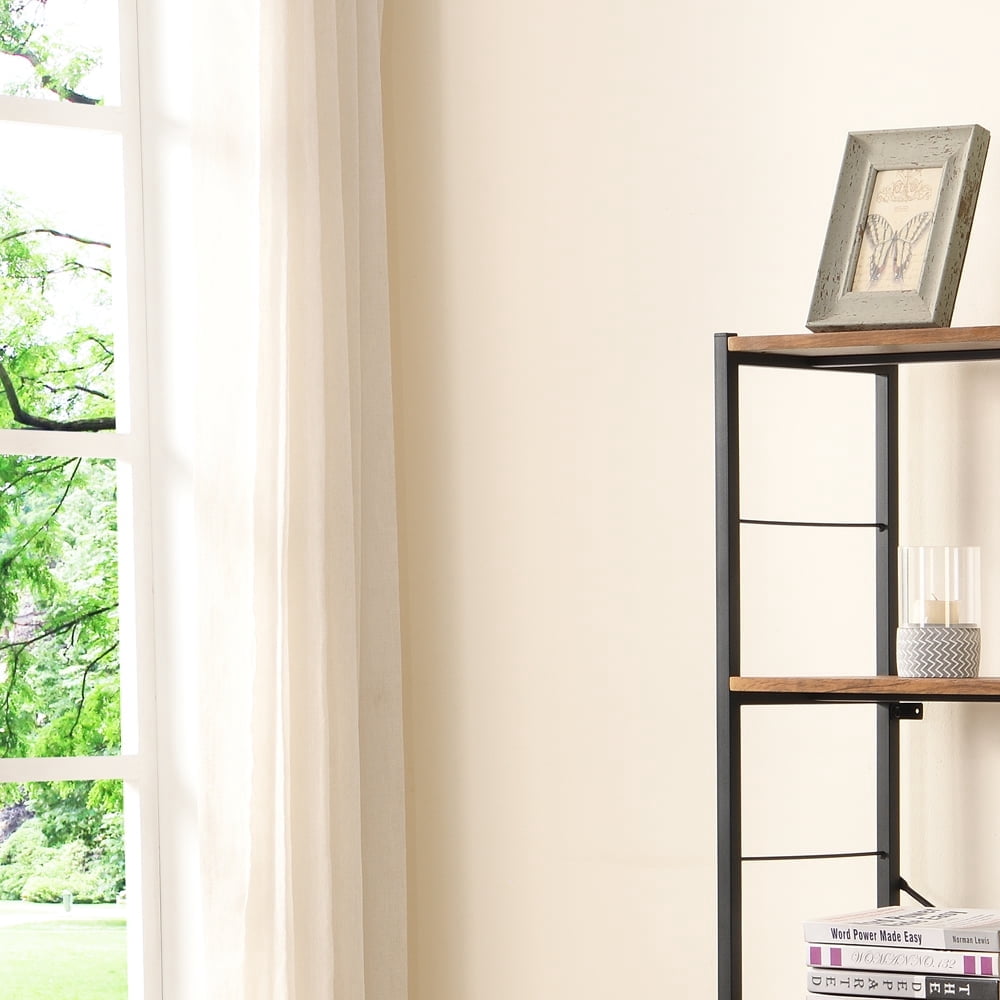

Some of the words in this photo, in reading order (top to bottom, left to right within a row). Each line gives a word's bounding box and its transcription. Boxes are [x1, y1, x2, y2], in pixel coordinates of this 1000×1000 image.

[830, 927, 851, 940] Word
[853, 928, 877, 942] Power
[879, 930, 902, 943] Made
[904, 931, 923, 946] Easy
[952, 935, 974, 945] Norman
[975, 936, 990, 945] Lewis
[811, 975, 923, 993] DEPARTED
[929, 982, 970, 995] THE
